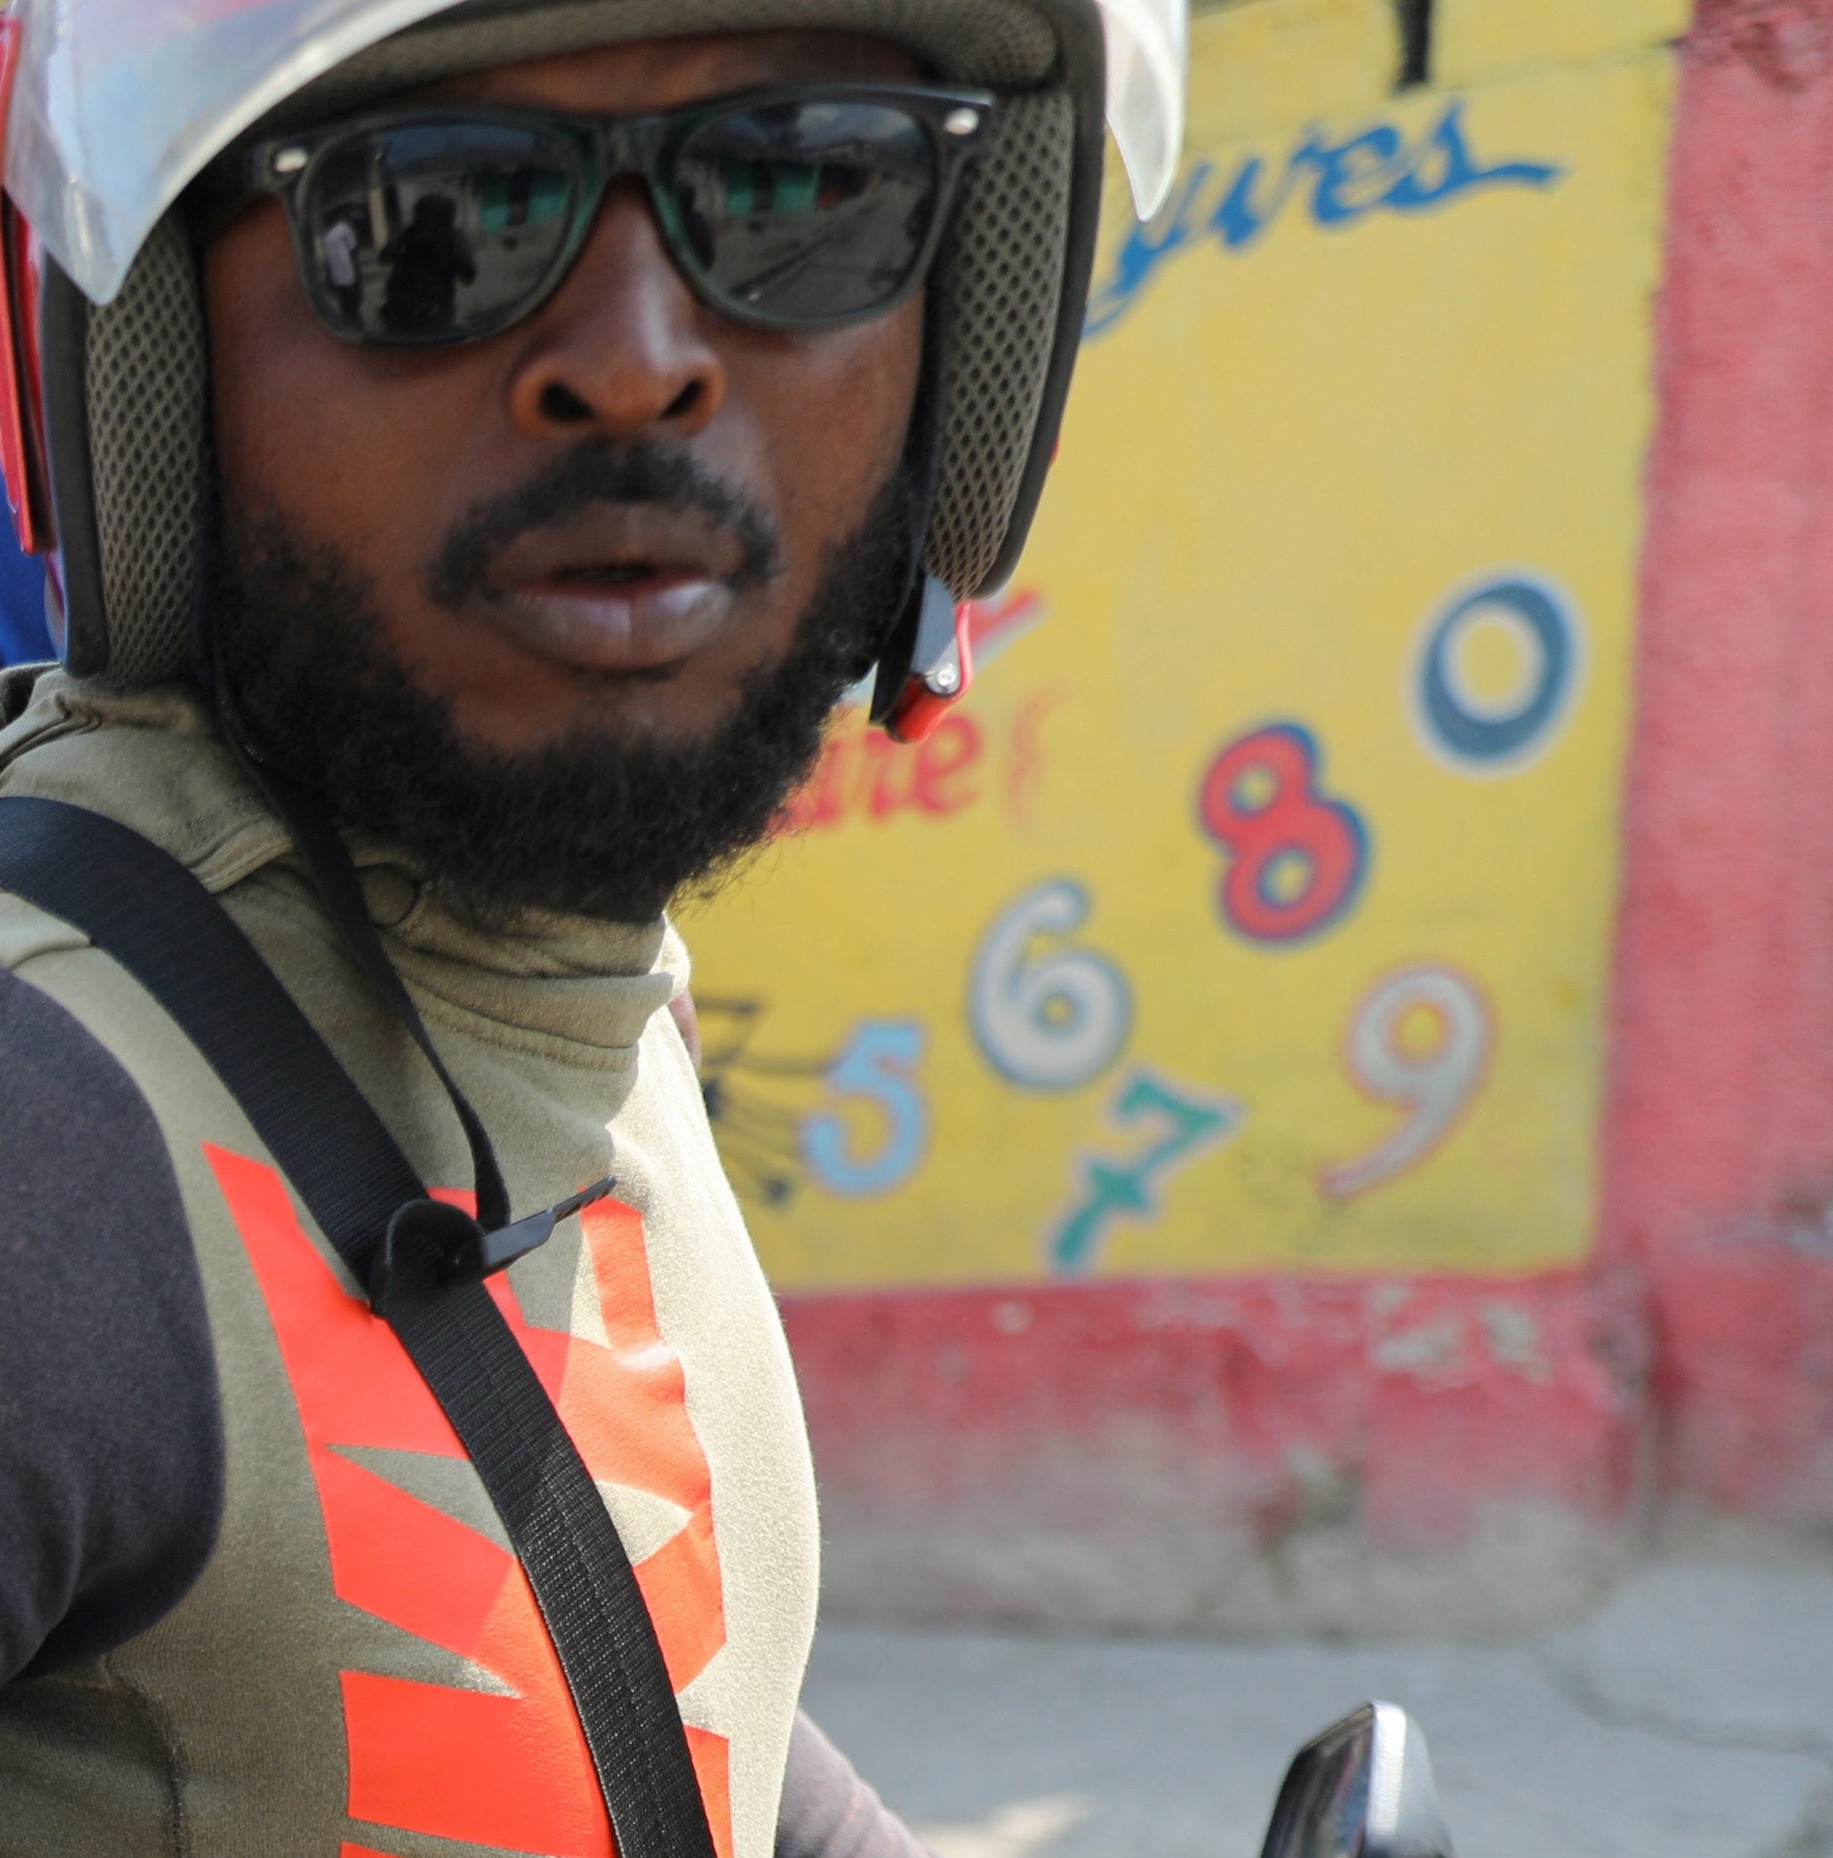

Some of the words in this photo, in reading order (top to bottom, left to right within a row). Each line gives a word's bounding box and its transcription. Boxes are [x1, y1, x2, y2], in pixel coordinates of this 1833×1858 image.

[1408, 570, 1581, 776] 0
[1199, 722, 1371, 950] 8
[967, 872, 1135, 1095] 6
[1315, 962, 1497, 1196] 9
[800, 1020, 925, 1197] 5
[1050, 1070, 1239, 1275] 7
